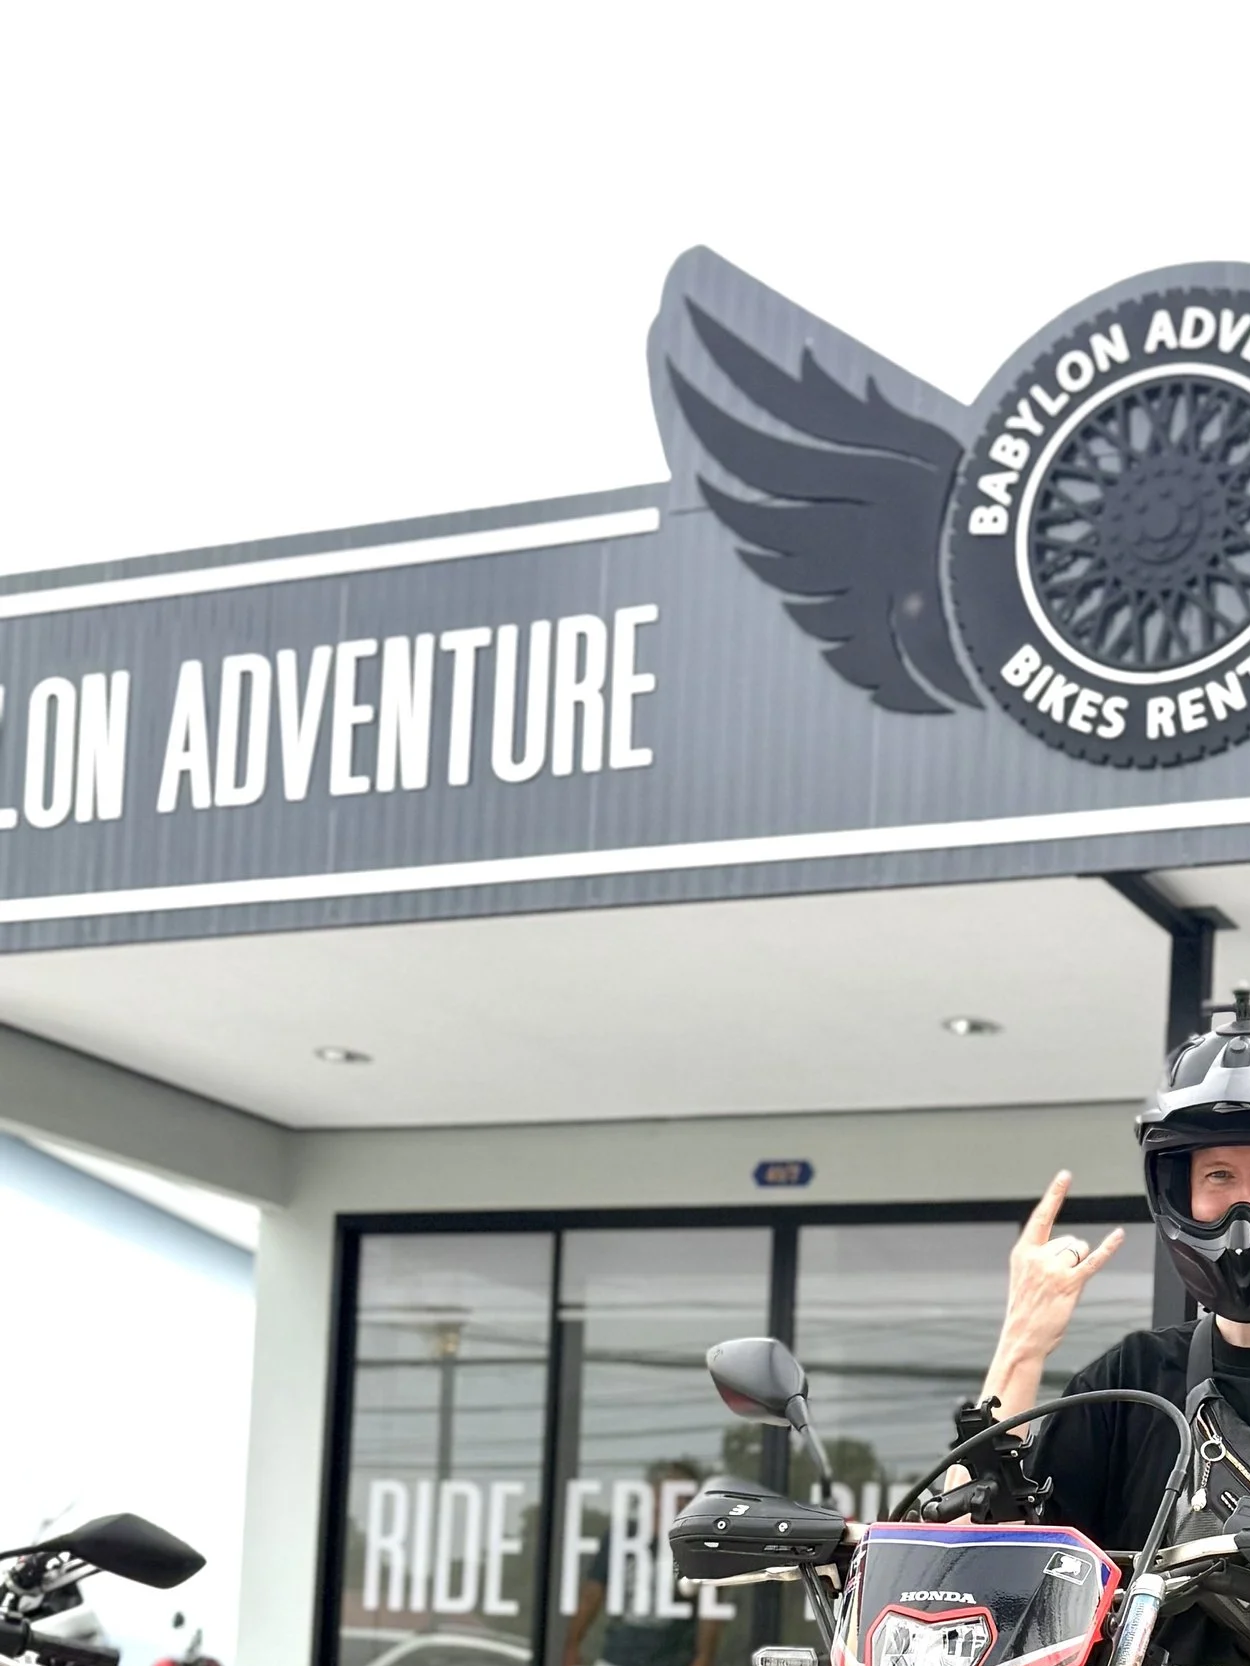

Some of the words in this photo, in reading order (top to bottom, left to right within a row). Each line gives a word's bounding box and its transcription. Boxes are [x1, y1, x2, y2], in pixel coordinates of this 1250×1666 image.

[969, 325, 1129, 535] BABYLON
[157, 603, 658, 814] ADVENTURE
[1000, 644, 1128, 740] BIKES
[362, 1480, 526, 1616] RIDE
[900, 1590, 977, 1605] HONDA
